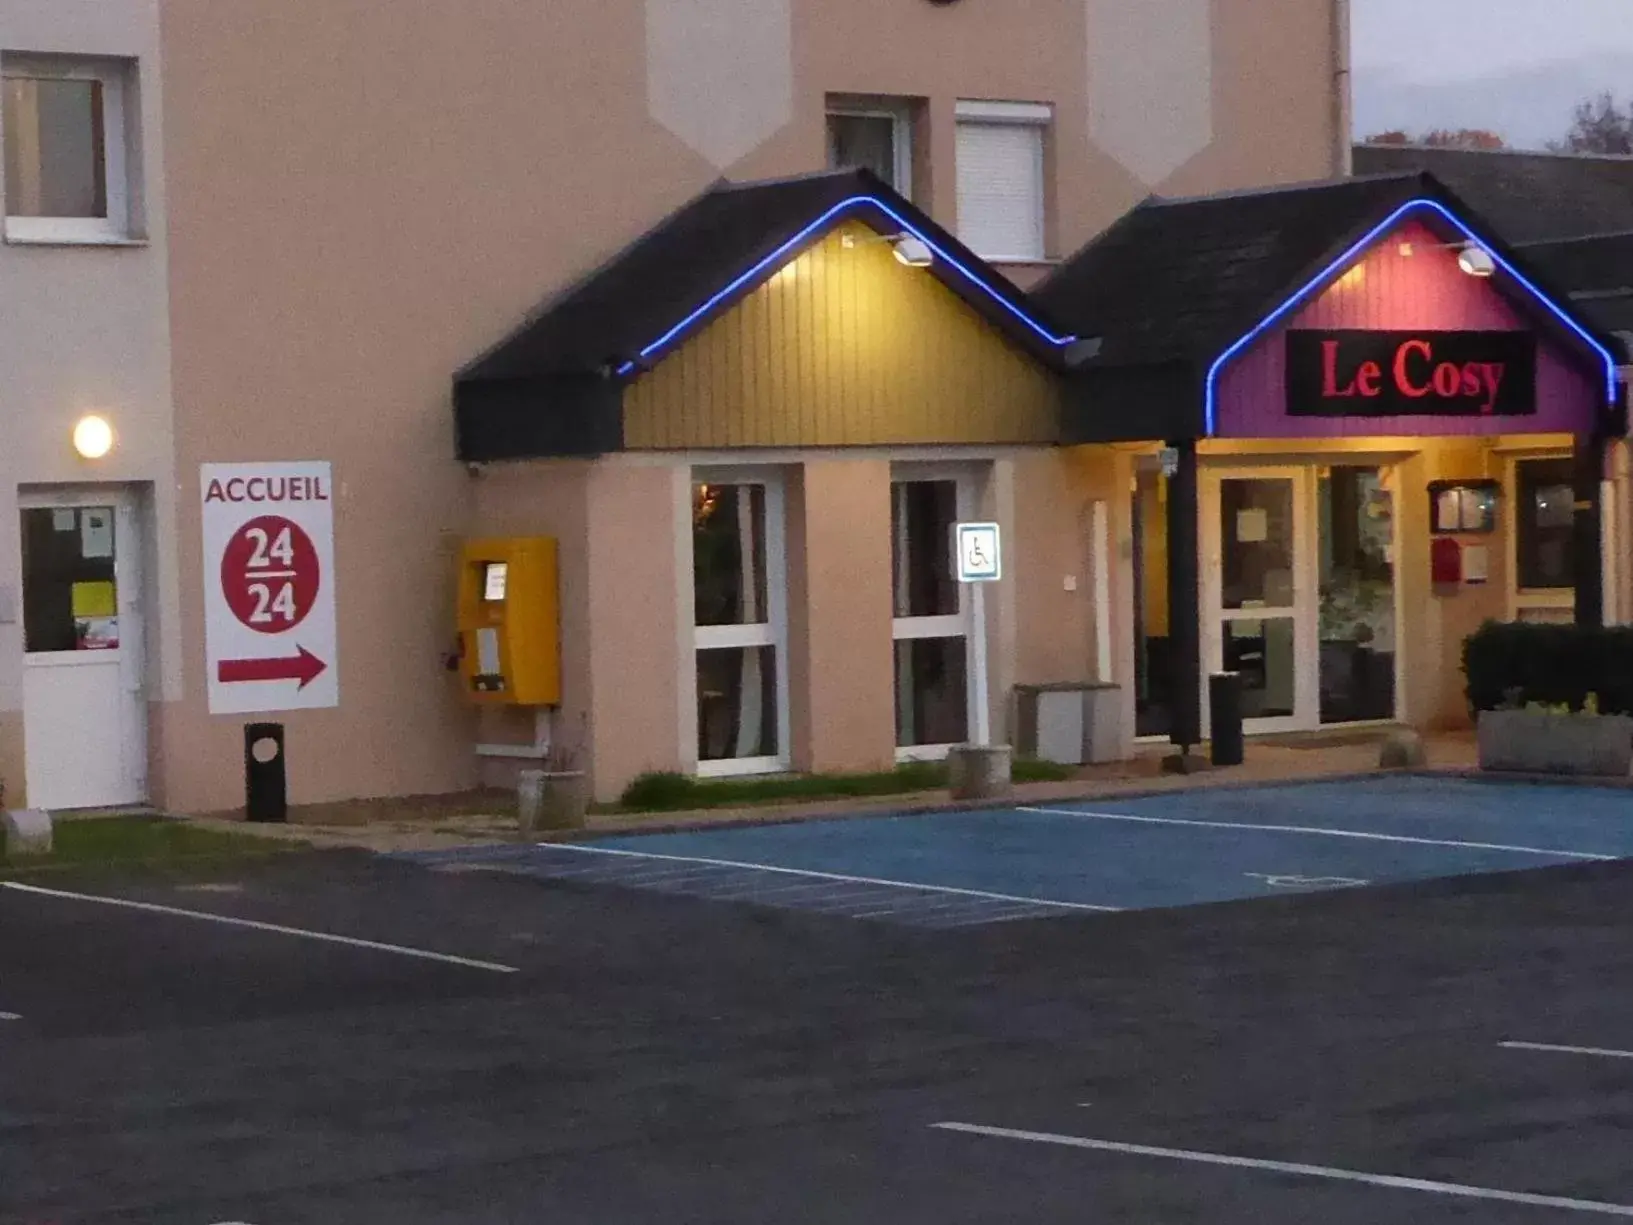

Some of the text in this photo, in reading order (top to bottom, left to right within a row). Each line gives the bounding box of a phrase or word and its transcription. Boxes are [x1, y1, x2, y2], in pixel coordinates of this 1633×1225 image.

[1321, 339, 1505, 415] Le Cosy
[204, 476, 328, 503] ACCUEIL
[245, 526, 294, 568] 24
[247, 581, 296, 623] 24
